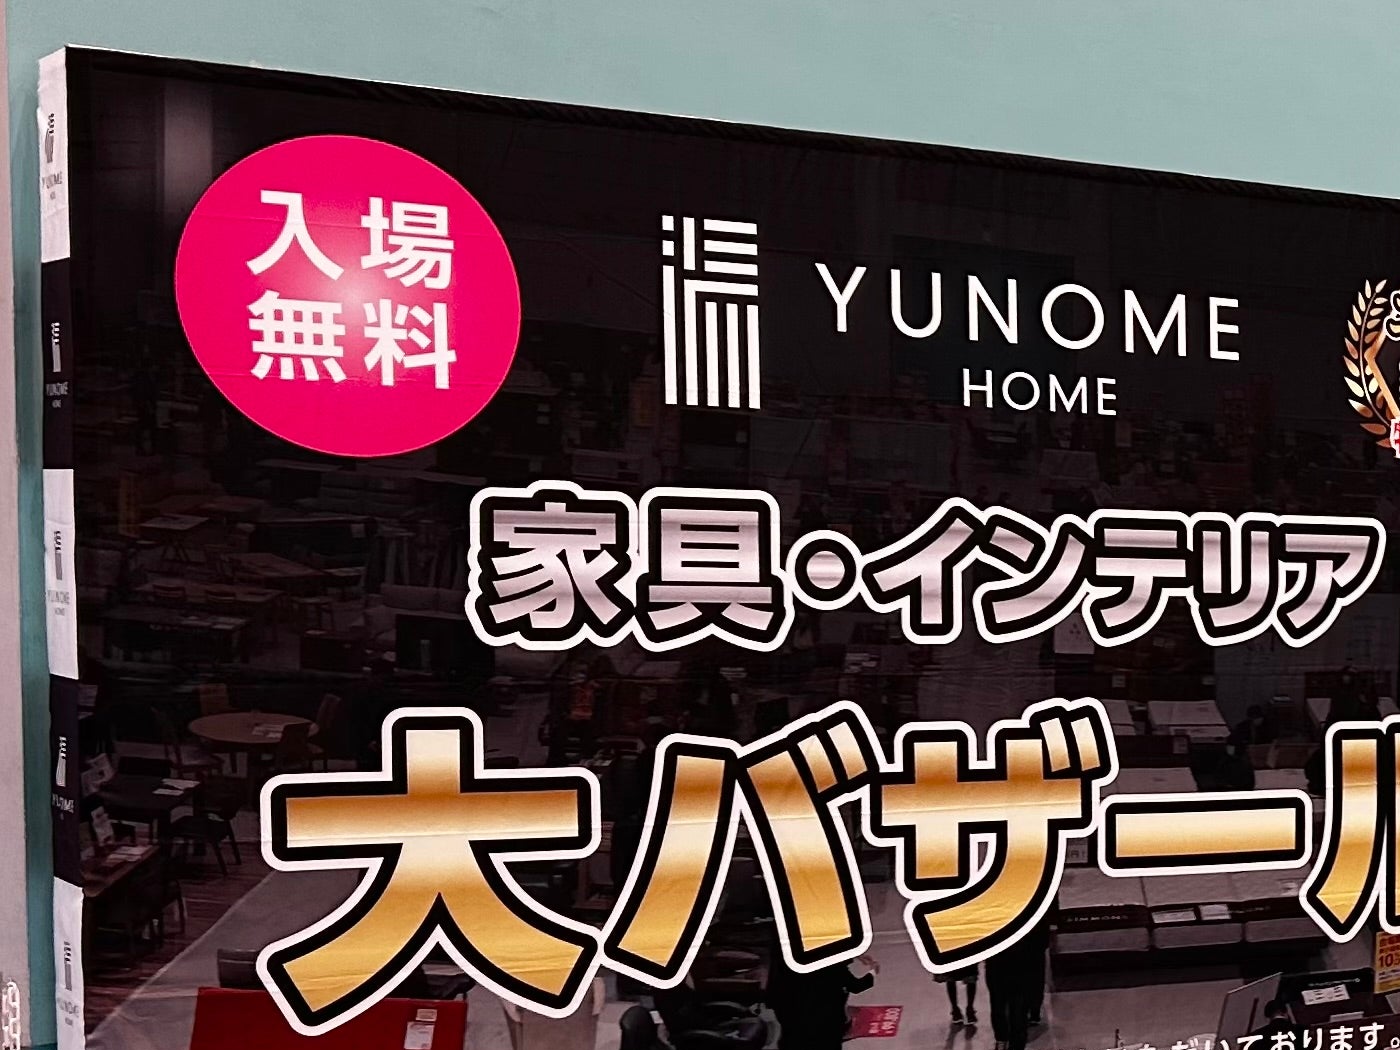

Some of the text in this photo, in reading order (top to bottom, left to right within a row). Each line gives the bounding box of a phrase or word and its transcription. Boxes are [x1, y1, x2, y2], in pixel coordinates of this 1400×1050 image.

[247, 190, 455, 289] 入場
[248, 290, 457, 390] 無料
[815, 263, 1241, 362] YUNOME
[962, 368, 1117, 417] HOME
[465, 480, 1387, 652] 家具・インテリア
